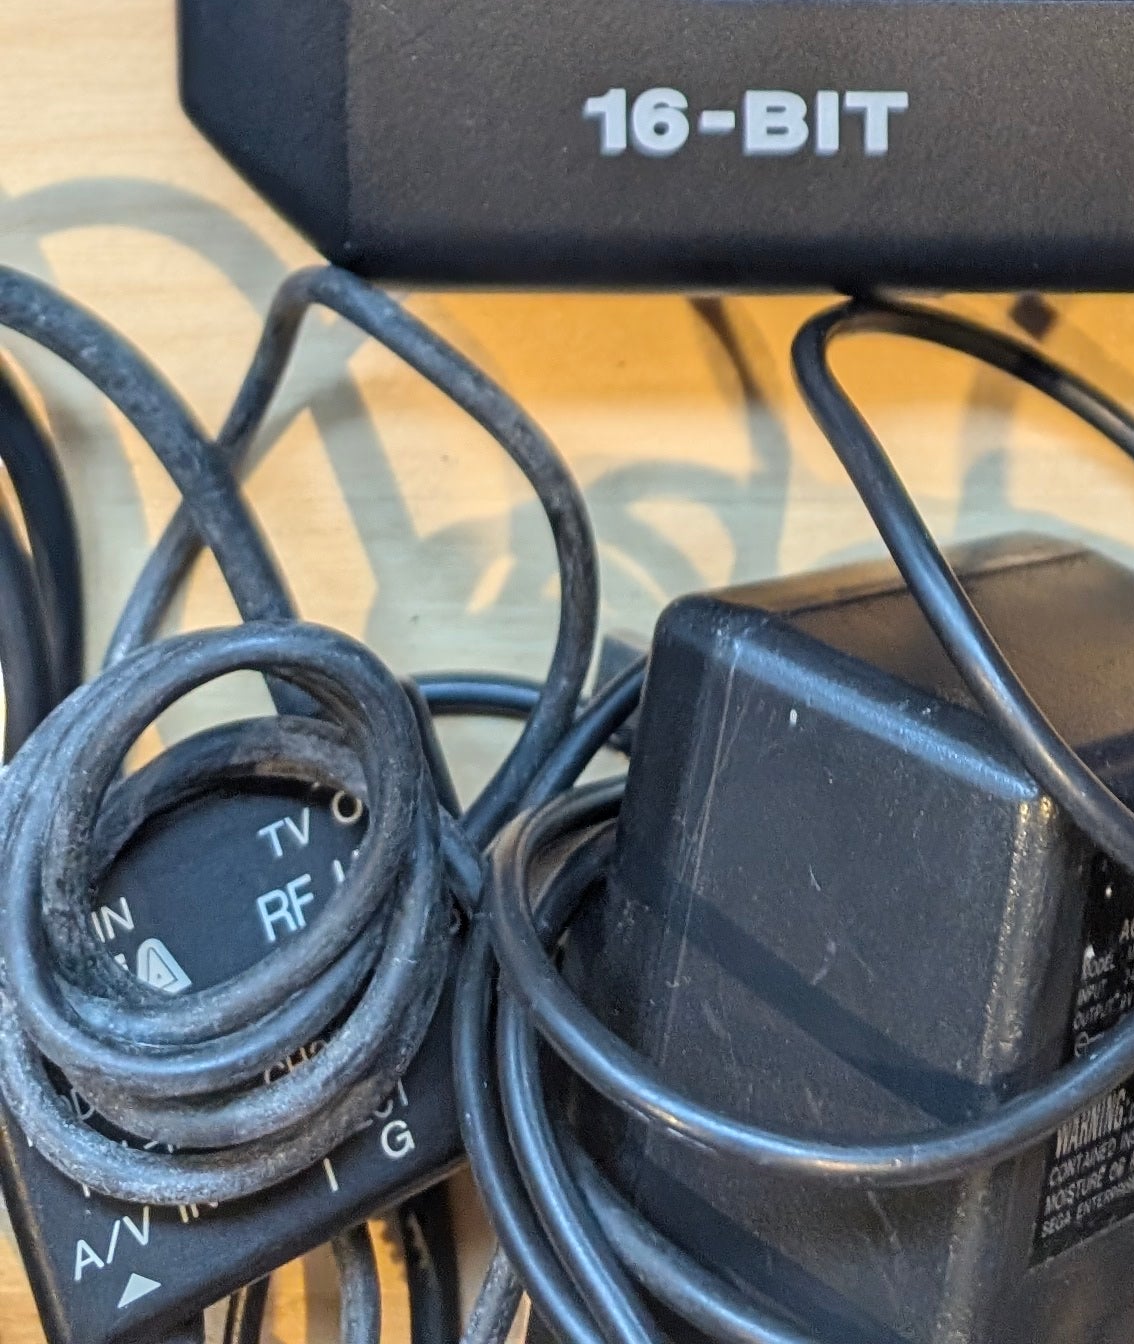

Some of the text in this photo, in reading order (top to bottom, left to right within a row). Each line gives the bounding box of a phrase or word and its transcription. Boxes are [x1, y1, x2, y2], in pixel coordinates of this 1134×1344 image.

[583, 87, 910, 157] 16-BIT
[256, 806, 311, 858] TV
[90, 895, 135, 944] IN
[255, 872, 315, 943] RF
[380, 1119, 416, 1159] G
[1050, 1138, 1116, 1186] CONTAINED
[1046, 1166, 1106, 1213] MOISTURE
[72, 1204, 150, 1281] A/V
[1042, 1211, 1071, 1237] SEGA
